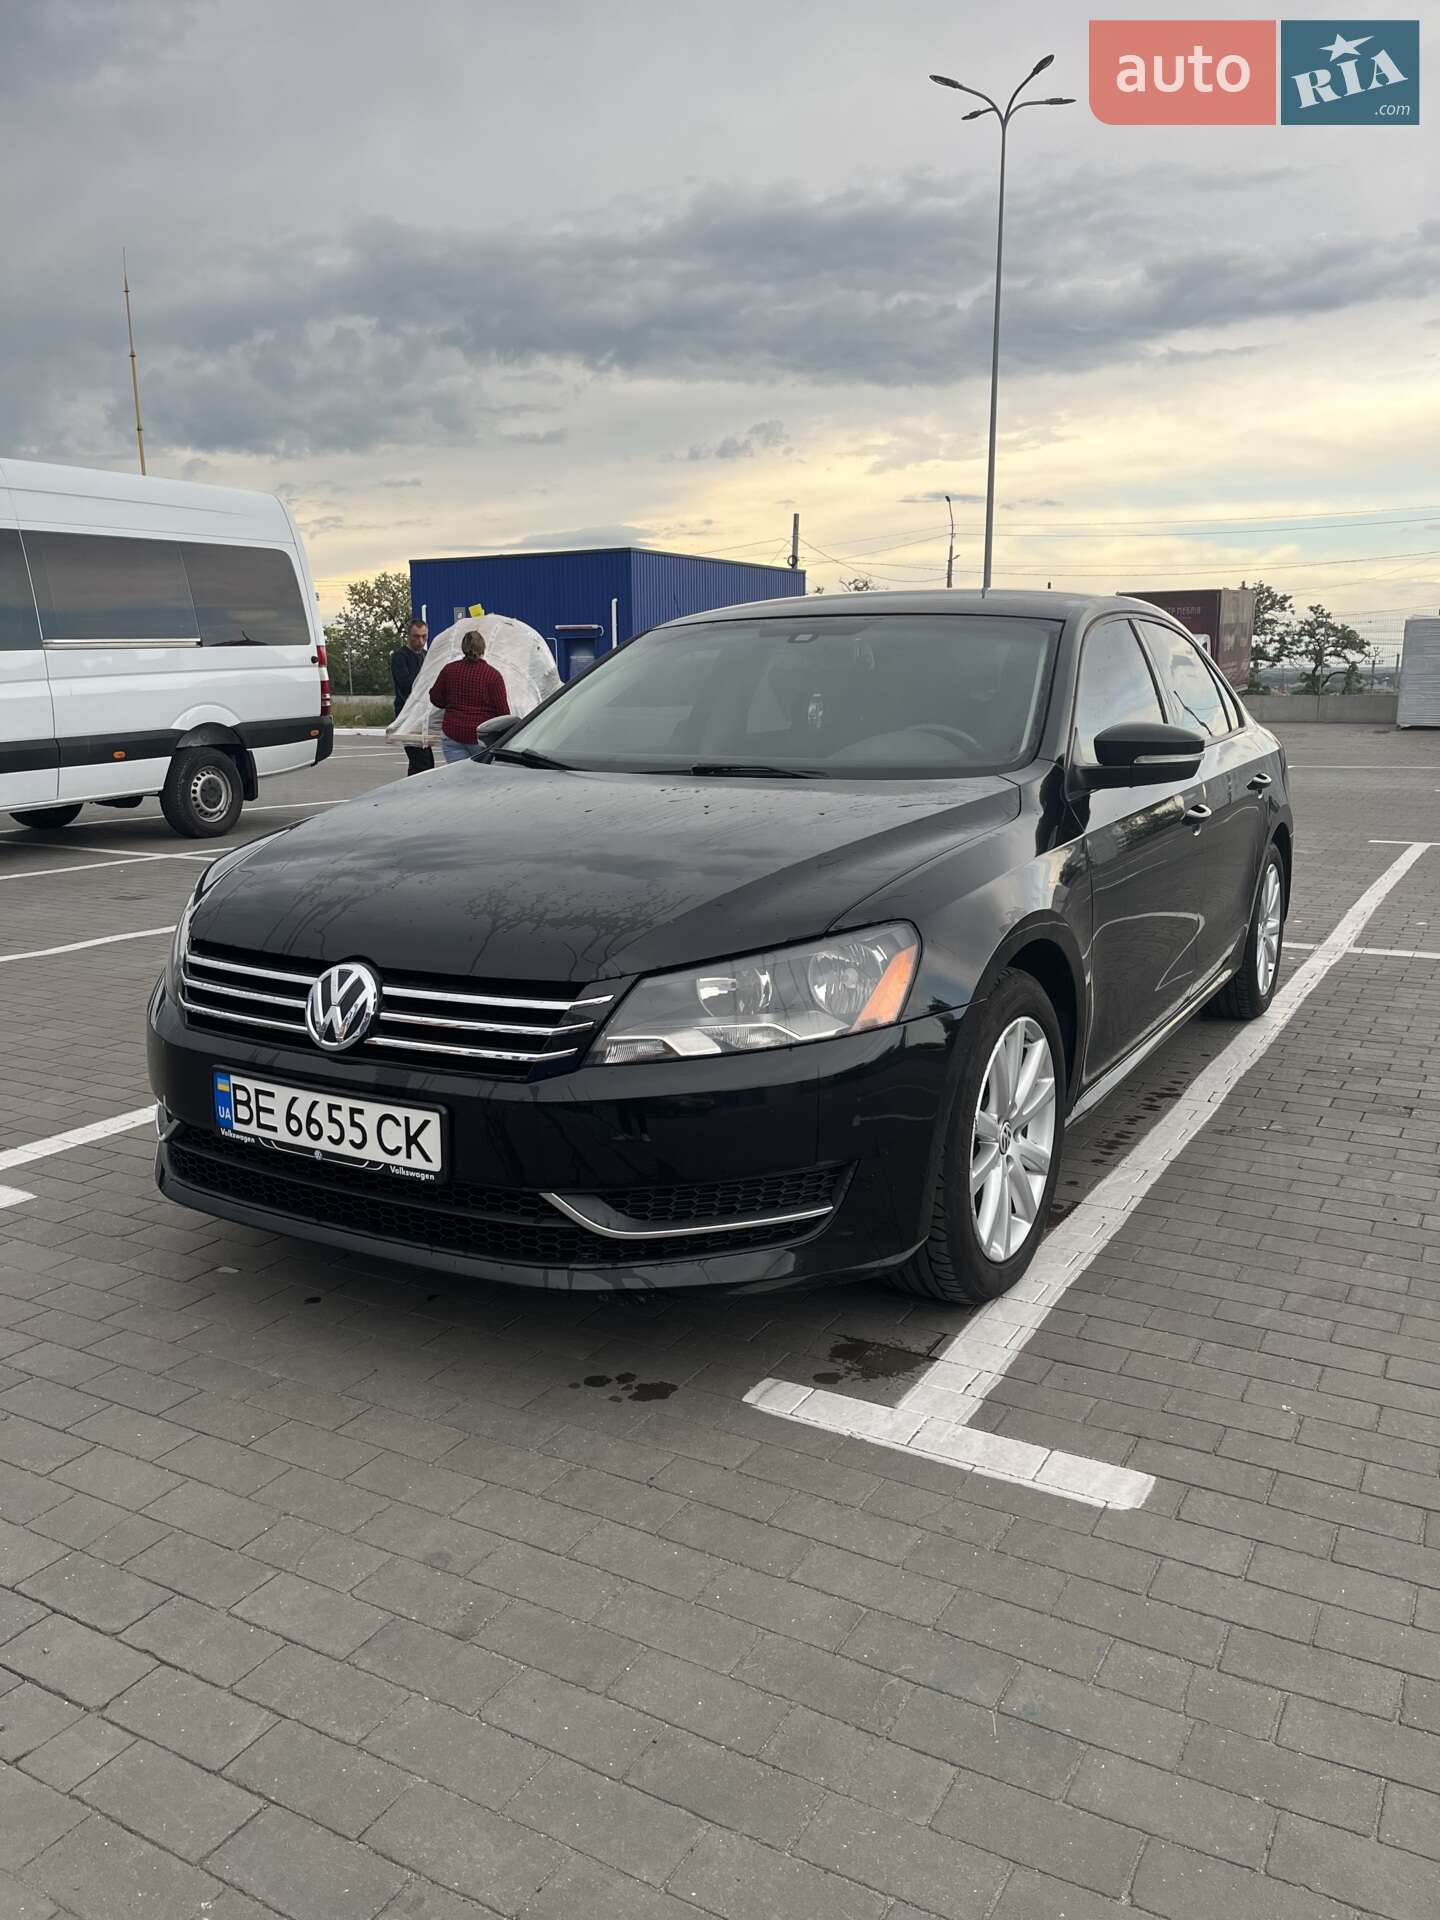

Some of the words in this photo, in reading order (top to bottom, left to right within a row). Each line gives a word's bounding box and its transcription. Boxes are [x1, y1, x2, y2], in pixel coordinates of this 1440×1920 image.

[218, 1106, 231, 1121] UA
[232, 1083, 278, 1132] BE
[285, 1096, 367, 1150] 6655
[377, 1113, 433, 1163] CK
[220, 1128, 255, 1144] Volkswagen
[389, 1165, 435, 1181] Volkswagen
